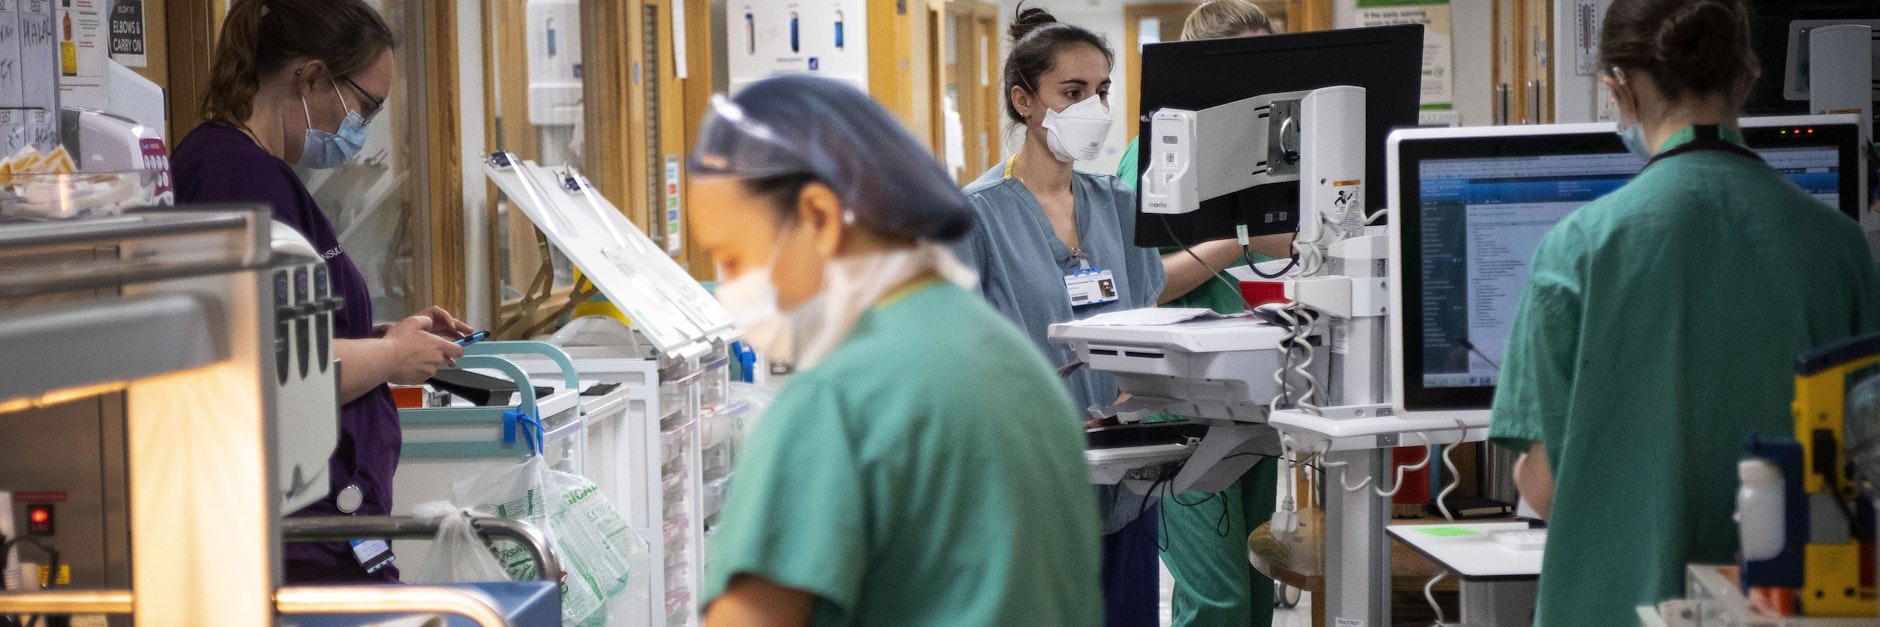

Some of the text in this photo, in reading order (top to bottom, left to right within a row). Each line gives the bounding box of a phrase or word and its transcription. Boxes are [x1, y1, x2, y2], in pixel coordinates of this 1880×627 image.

[113, 20, 135, 34] ELBOWS
[136, 21, 142, 34] &
[112, 38, 142, 52] CARRY ON
